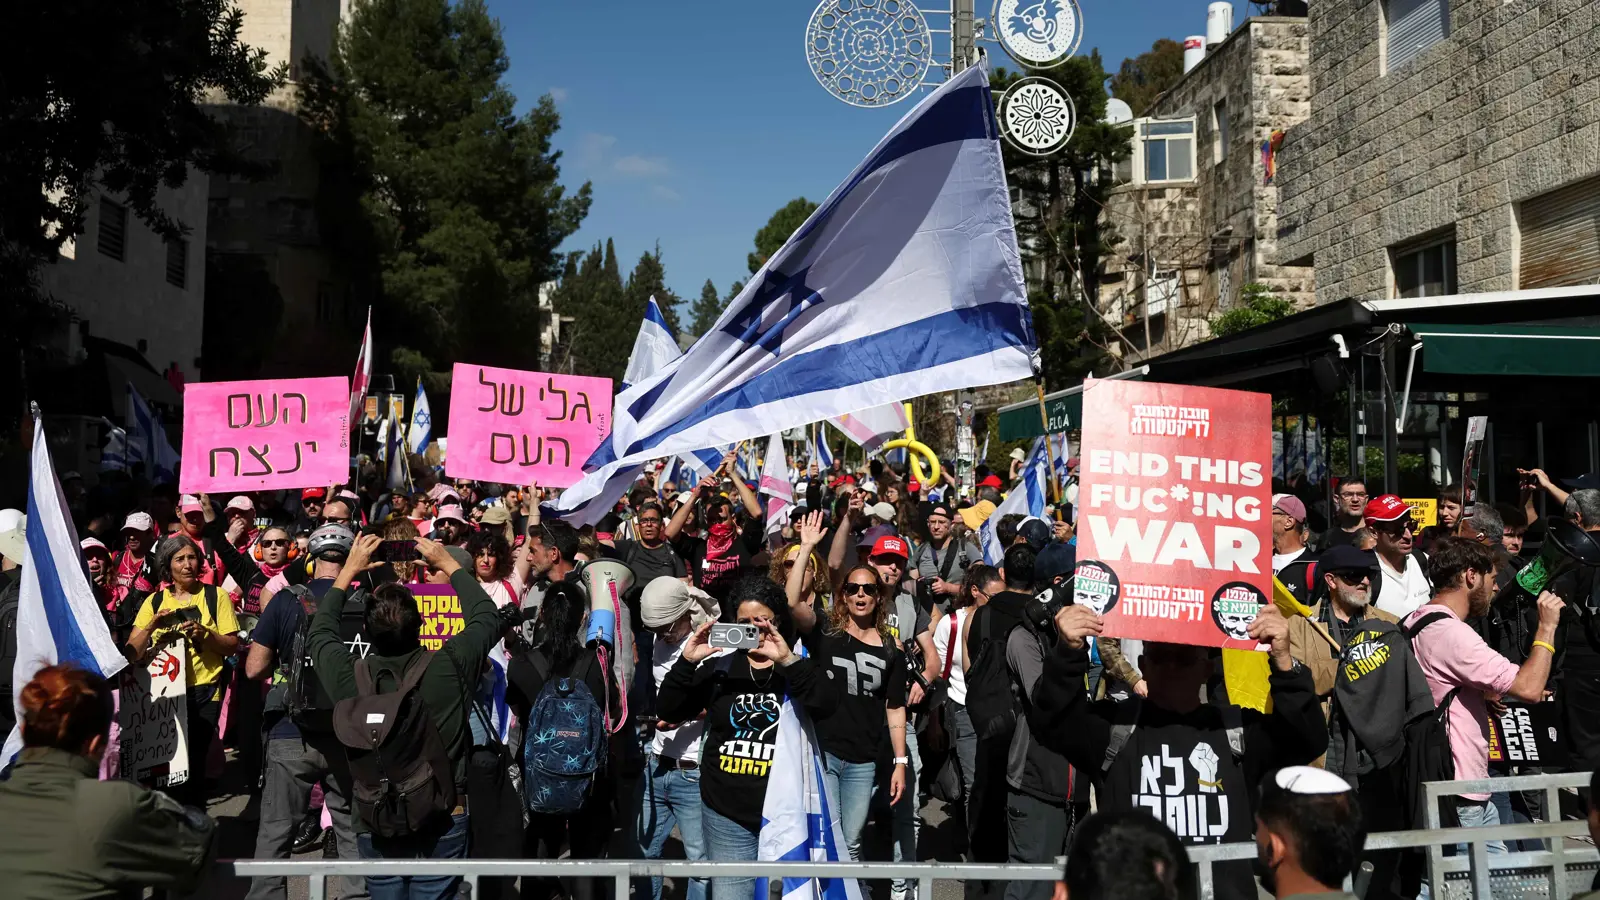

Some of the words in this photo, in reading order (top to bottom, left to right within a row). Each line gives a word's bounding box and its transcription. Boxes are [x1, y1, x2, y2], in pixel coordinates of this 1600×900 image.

[228, 392, 308, 429] העם
[478, 368, 524, 416] של
[539, 377, 592, 424] גלי
[1131, 403, 1177, 419] להתנגד
[1178, 406, 1210, 421] חובה
[209, 440, 319, 478] ינצח
[490, 432, 570, 467] העם
[1089, 449, 1169, 477] END
[1175, 455, 1264, 487] THIS
[1087, 514, 1262, 574] WAR
[1123, 583, 1170, 600] להתנגד
[1123, 597, 1205, 622] לדיקטטורה
[1171, 586, 1205, 603] חובה
[1344, 663, 1360, 682] IS
[1514, 707, 1540, 761] למלחמה
[1140, 743, 1185, 796] לא
